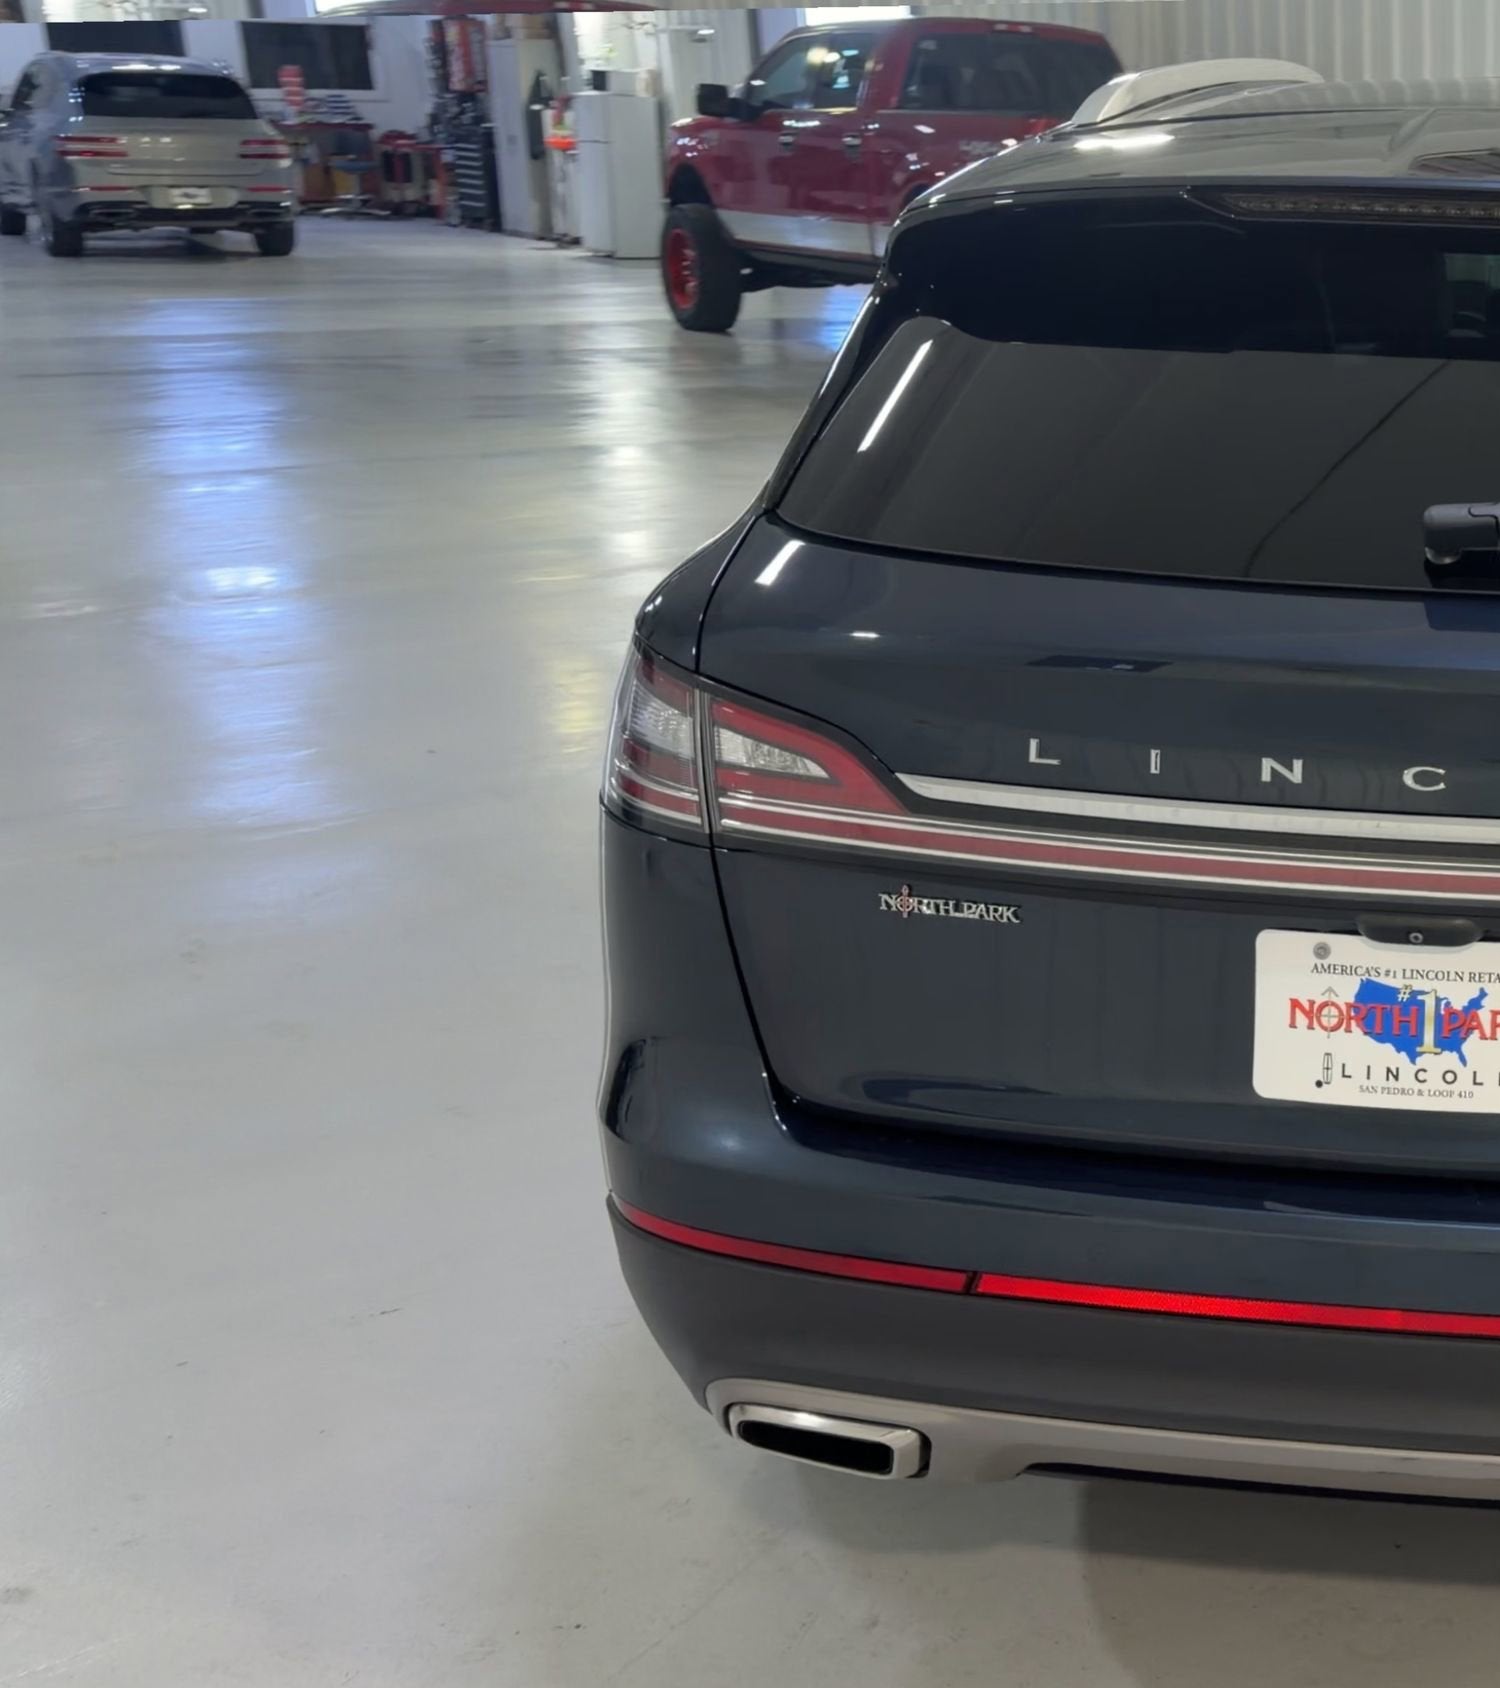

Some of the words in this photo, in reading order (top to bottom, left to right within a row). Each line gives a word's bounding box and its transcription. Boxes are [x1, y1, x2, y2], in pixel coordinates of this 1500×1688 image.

[878, 893, 957, 916] NORTH
[960, 902, 1020, 923] PARK
[1311, 963, 1381, 978] AMERICA'S
[1384, 969, 1397, 979] #1
[1402, 969, 1464, 982] LINCOLN
[1288, 998, 1418, 1038] NORTH
[1359, 1084, 1378, 1094] SAN
[1380, 1086, 1415, 1096] PEDRO
[1416, 1088, 1425, 1097] &
[1456, 1090, 1475, 1099] 410
